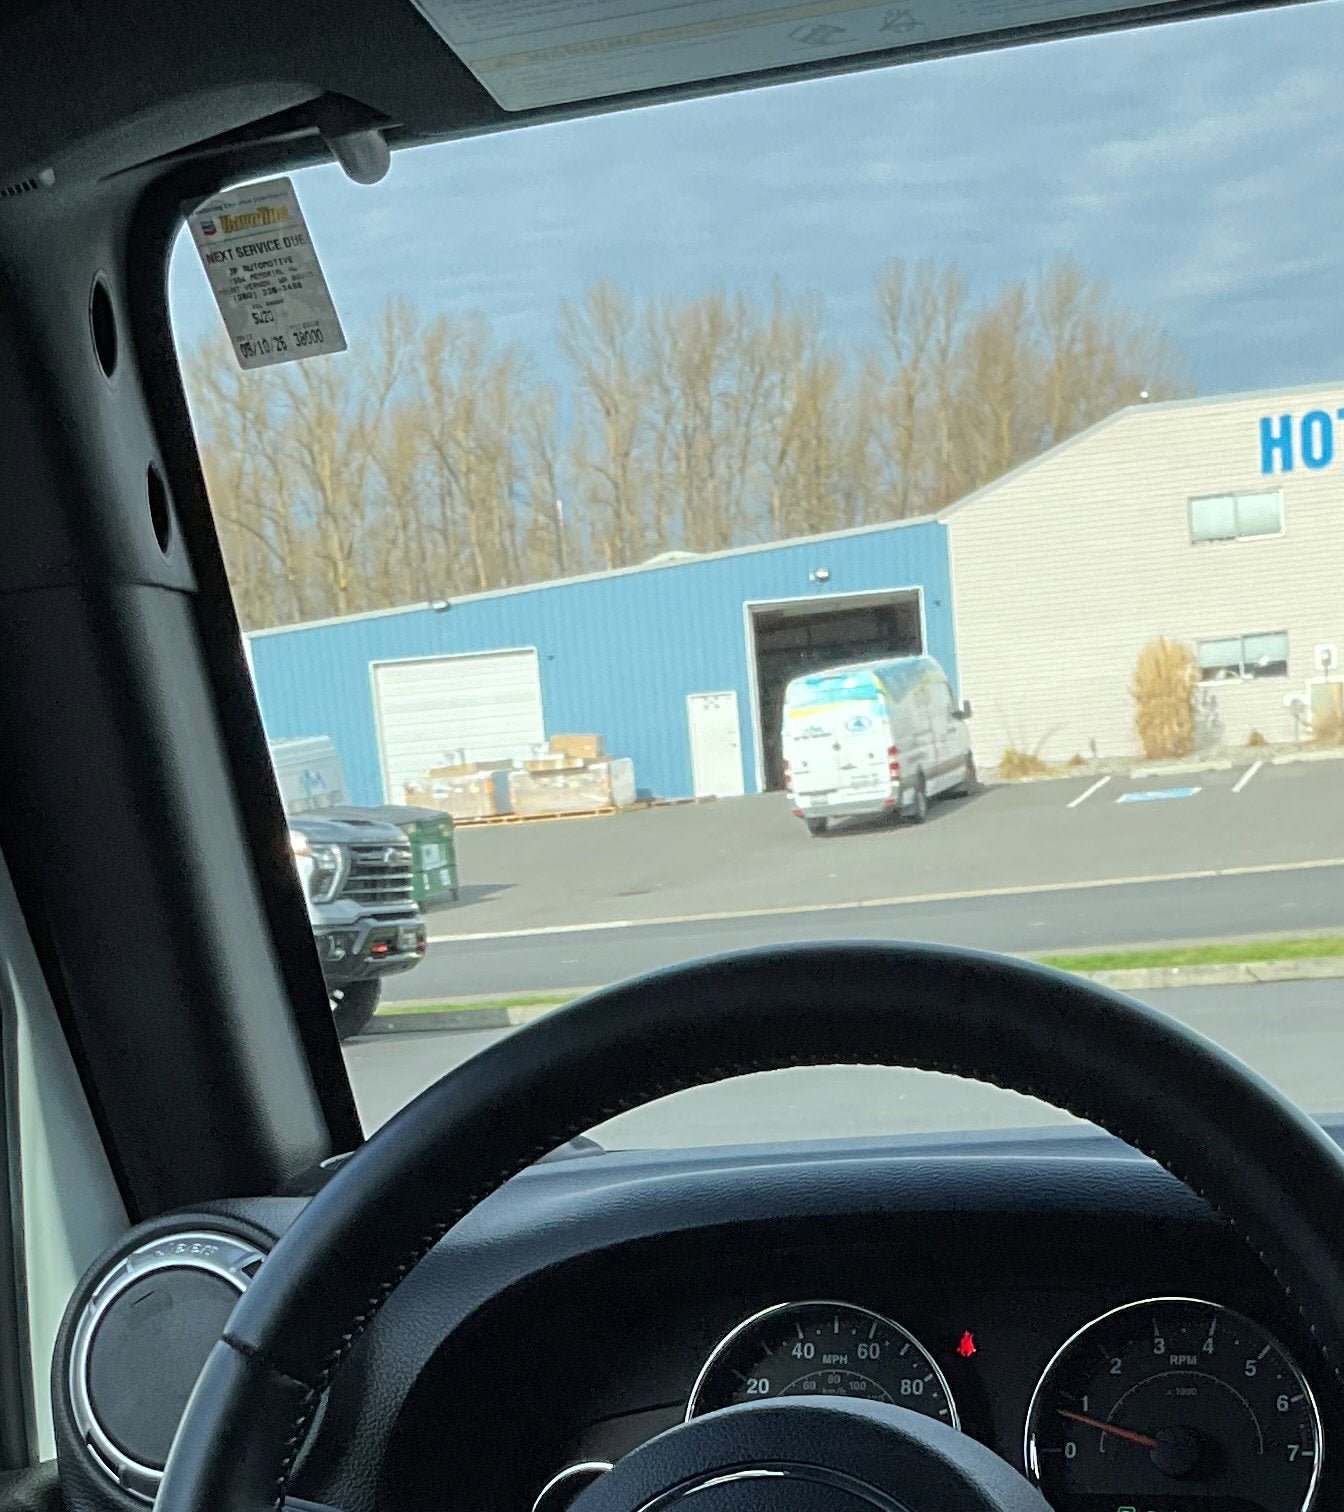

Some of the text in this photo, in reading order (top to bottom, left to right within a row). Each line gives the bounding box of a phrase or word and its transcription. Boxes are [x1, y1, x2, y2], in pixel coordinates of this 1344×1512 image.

[206, 233, 306, 265] NEXT SERVICE DUE
[790, 1341, 816, 1360] 40
[856, 1342, 882, 1361] 60
[1153, 1337, 1166, 1356] 3
[1201, 1337, 1215, 1355] 4
[821, 1353, 849, 1366] MPH
[1109, 1357, 1123, 1375] 2
[1169, 1354, 1198, 1367] RPM
[1244, 1359, 1257, 1378] 5
[745, 1377, 771, 1395] 20
[899, 1378, 925, 1396] 80
[1082, 1395, 1090, 1413] 1
[1276, 1394, 1290, 1413] 6
[1064, 1441, 1077, 1459] 0
[1286, 1444, 1300, 1462] 7
